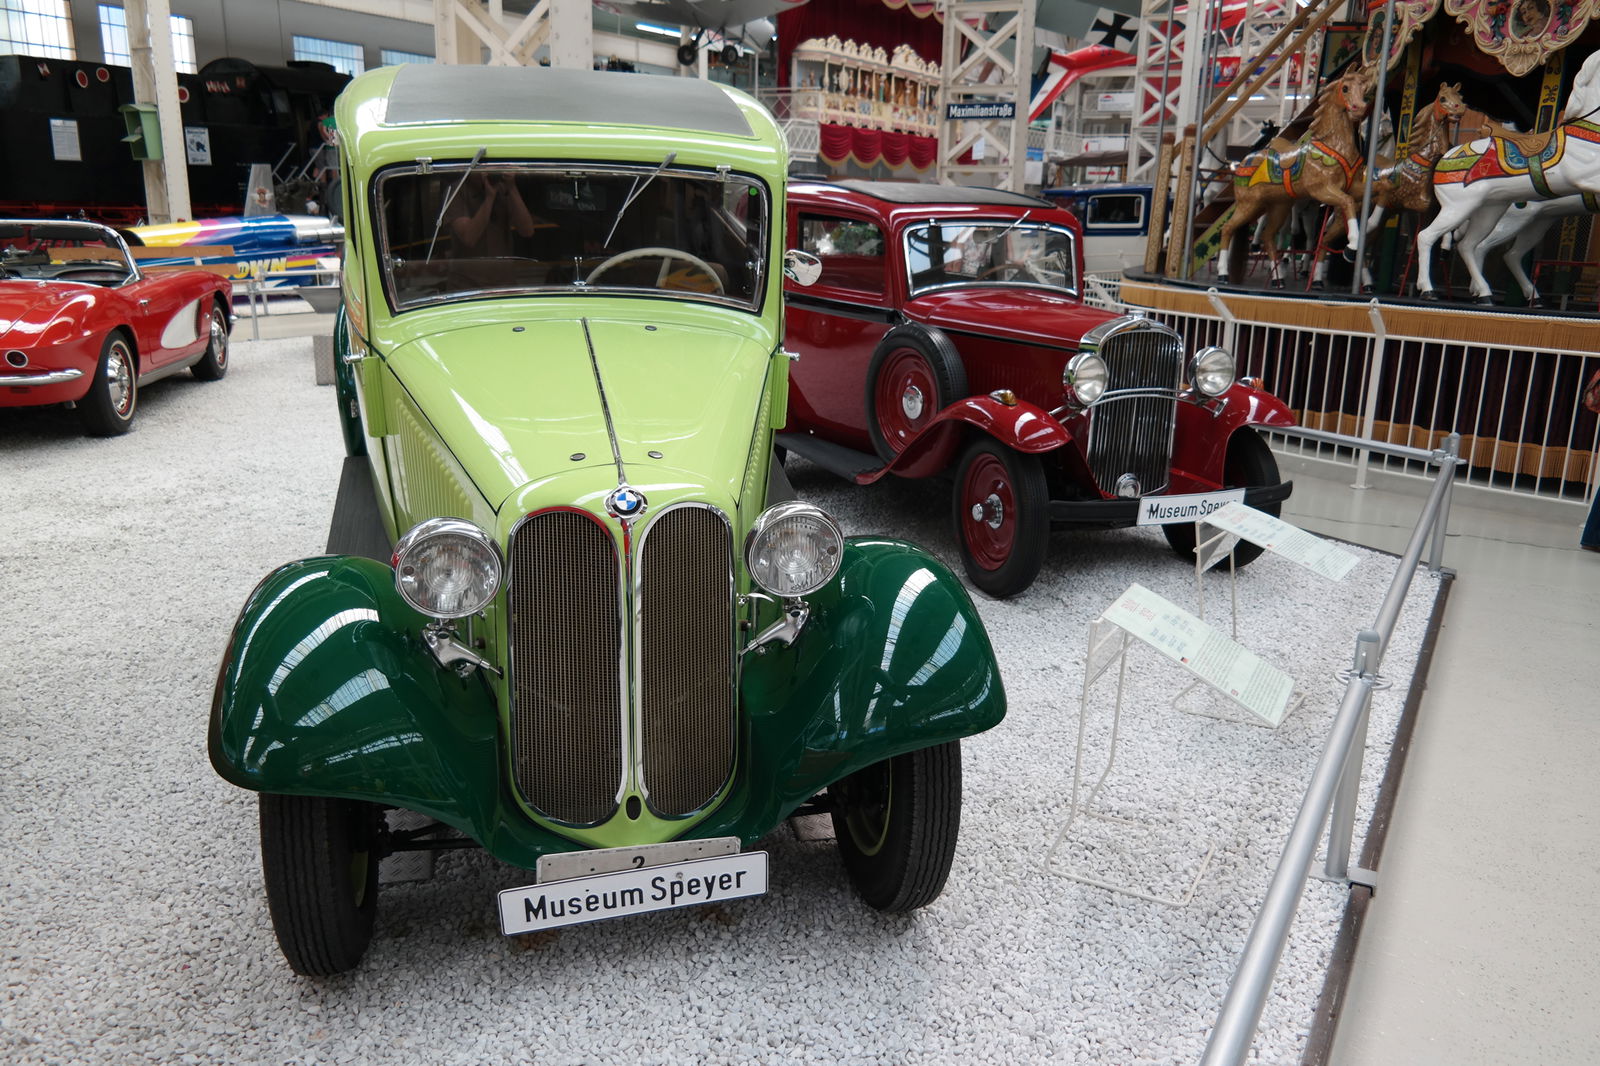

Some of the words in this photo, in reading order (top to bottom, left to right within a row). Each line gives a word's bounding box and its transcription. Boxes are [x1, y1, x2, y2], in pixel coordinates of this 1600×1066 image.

[949, 103, 1013, 118] Maximilianstraße
[1148, 503, 1198, 519] Museum
[524, 887, 644, 922] Museum
[651, 870, 747, 905] Speyer
